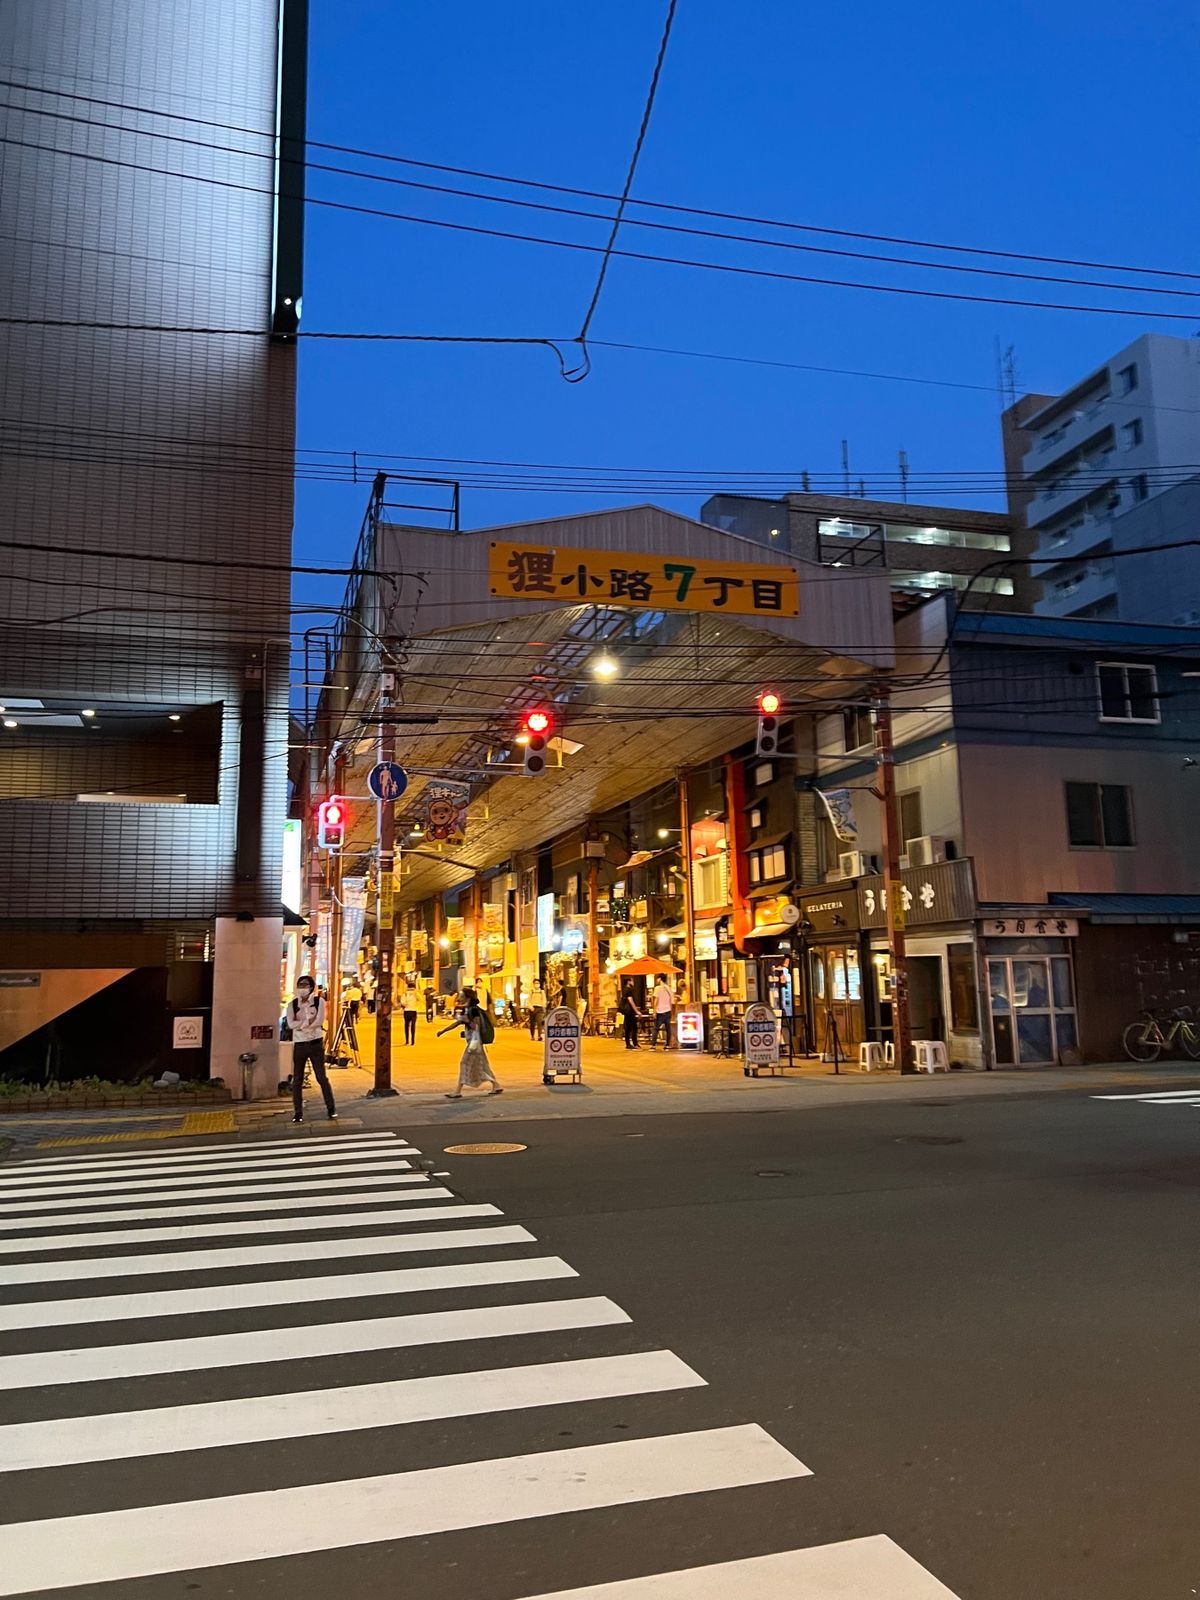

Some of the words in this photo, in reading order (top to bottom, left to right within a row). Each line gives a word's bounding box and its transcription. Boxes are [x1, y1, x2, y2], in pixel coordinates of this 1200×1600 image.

[507, 550, 783, 611] 狸小路7丁目
[806, 901, 844, 913] GELATERIA
